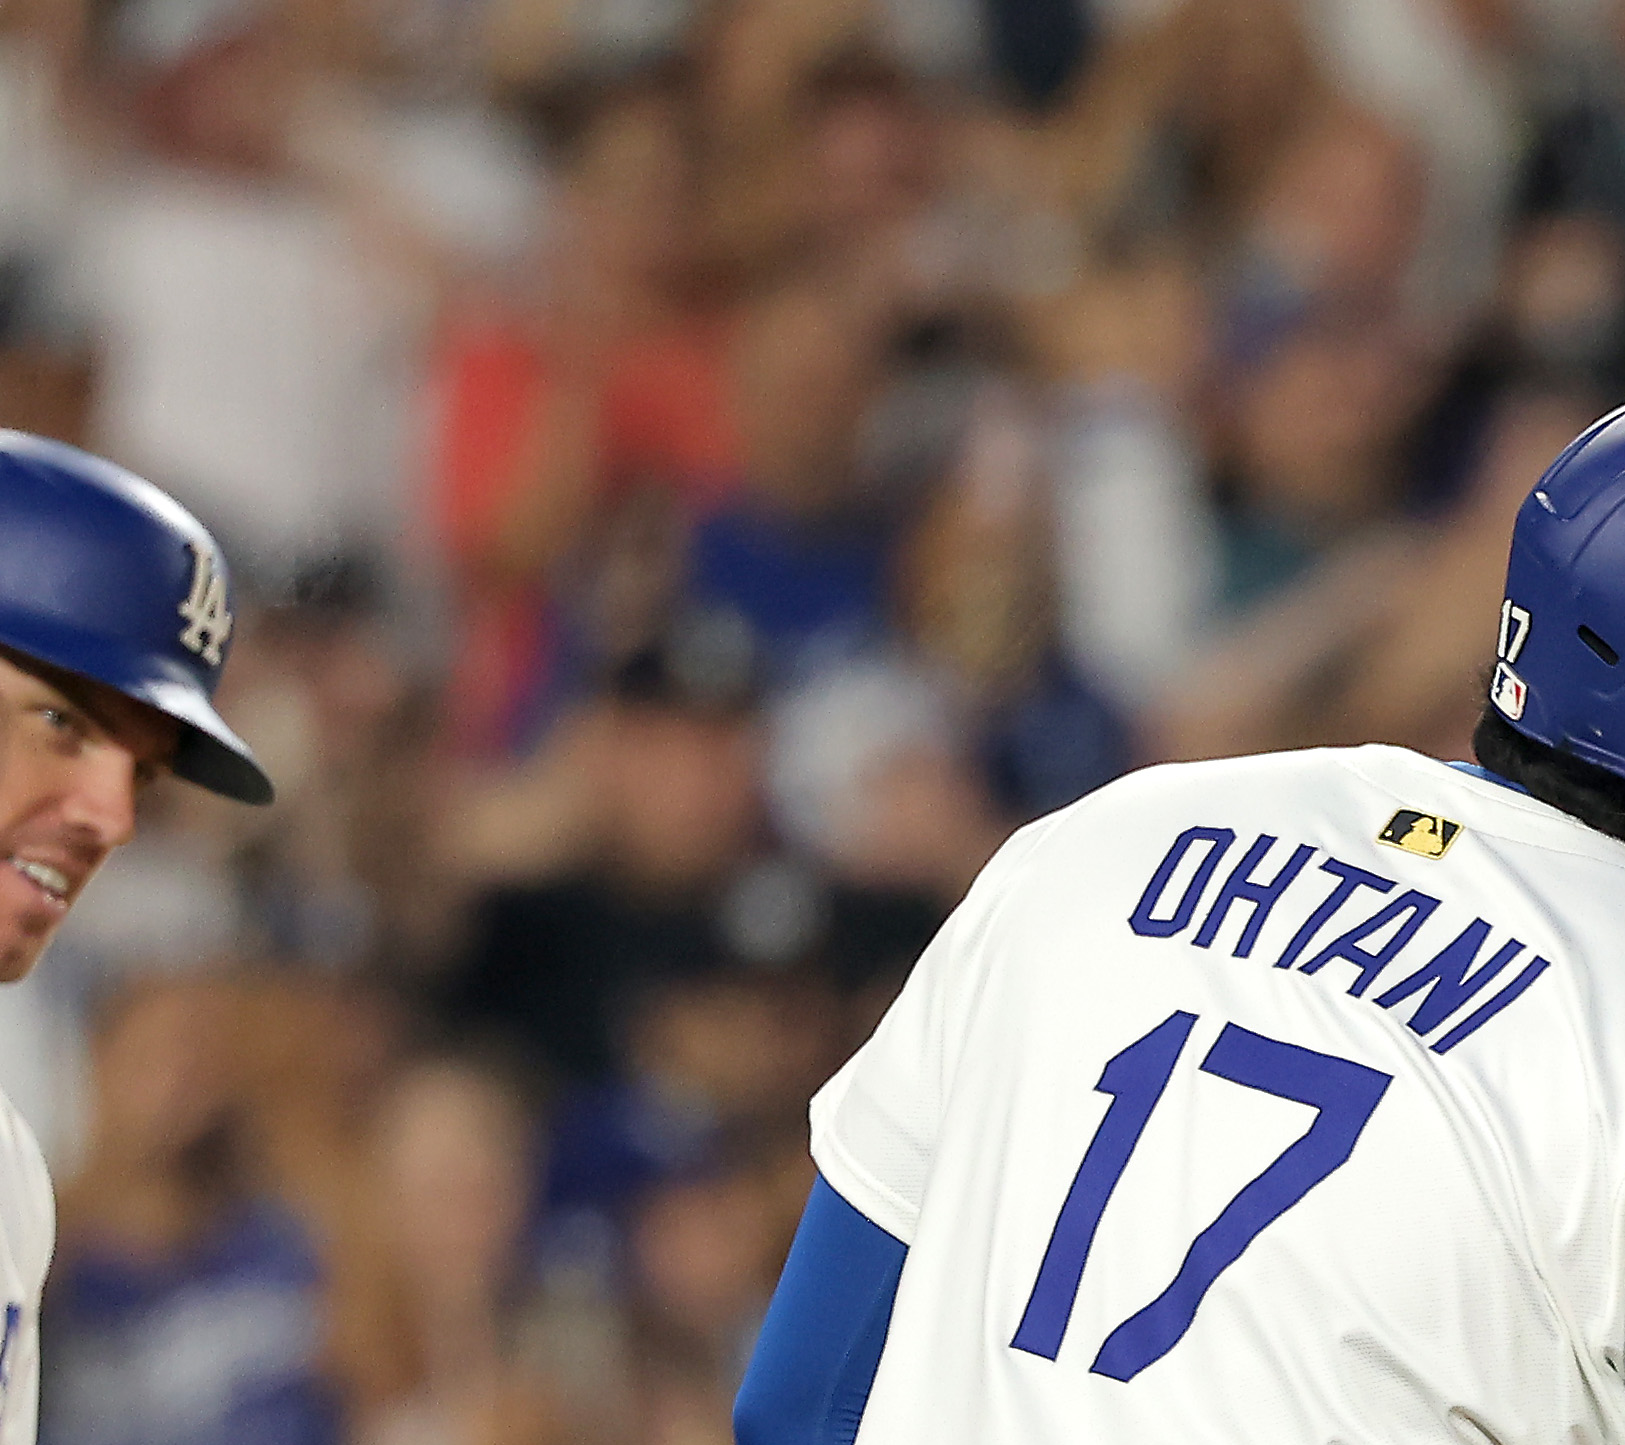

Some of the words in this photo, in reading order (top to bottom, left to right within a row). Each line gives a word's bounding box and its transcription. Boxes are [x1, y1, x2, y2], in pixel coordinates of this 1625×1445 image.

[1497, 597, 1533, 666] 17
[1127, 825, 1551, 1056] OHTANI
[1008, 1009, 1395, 1384] 17
